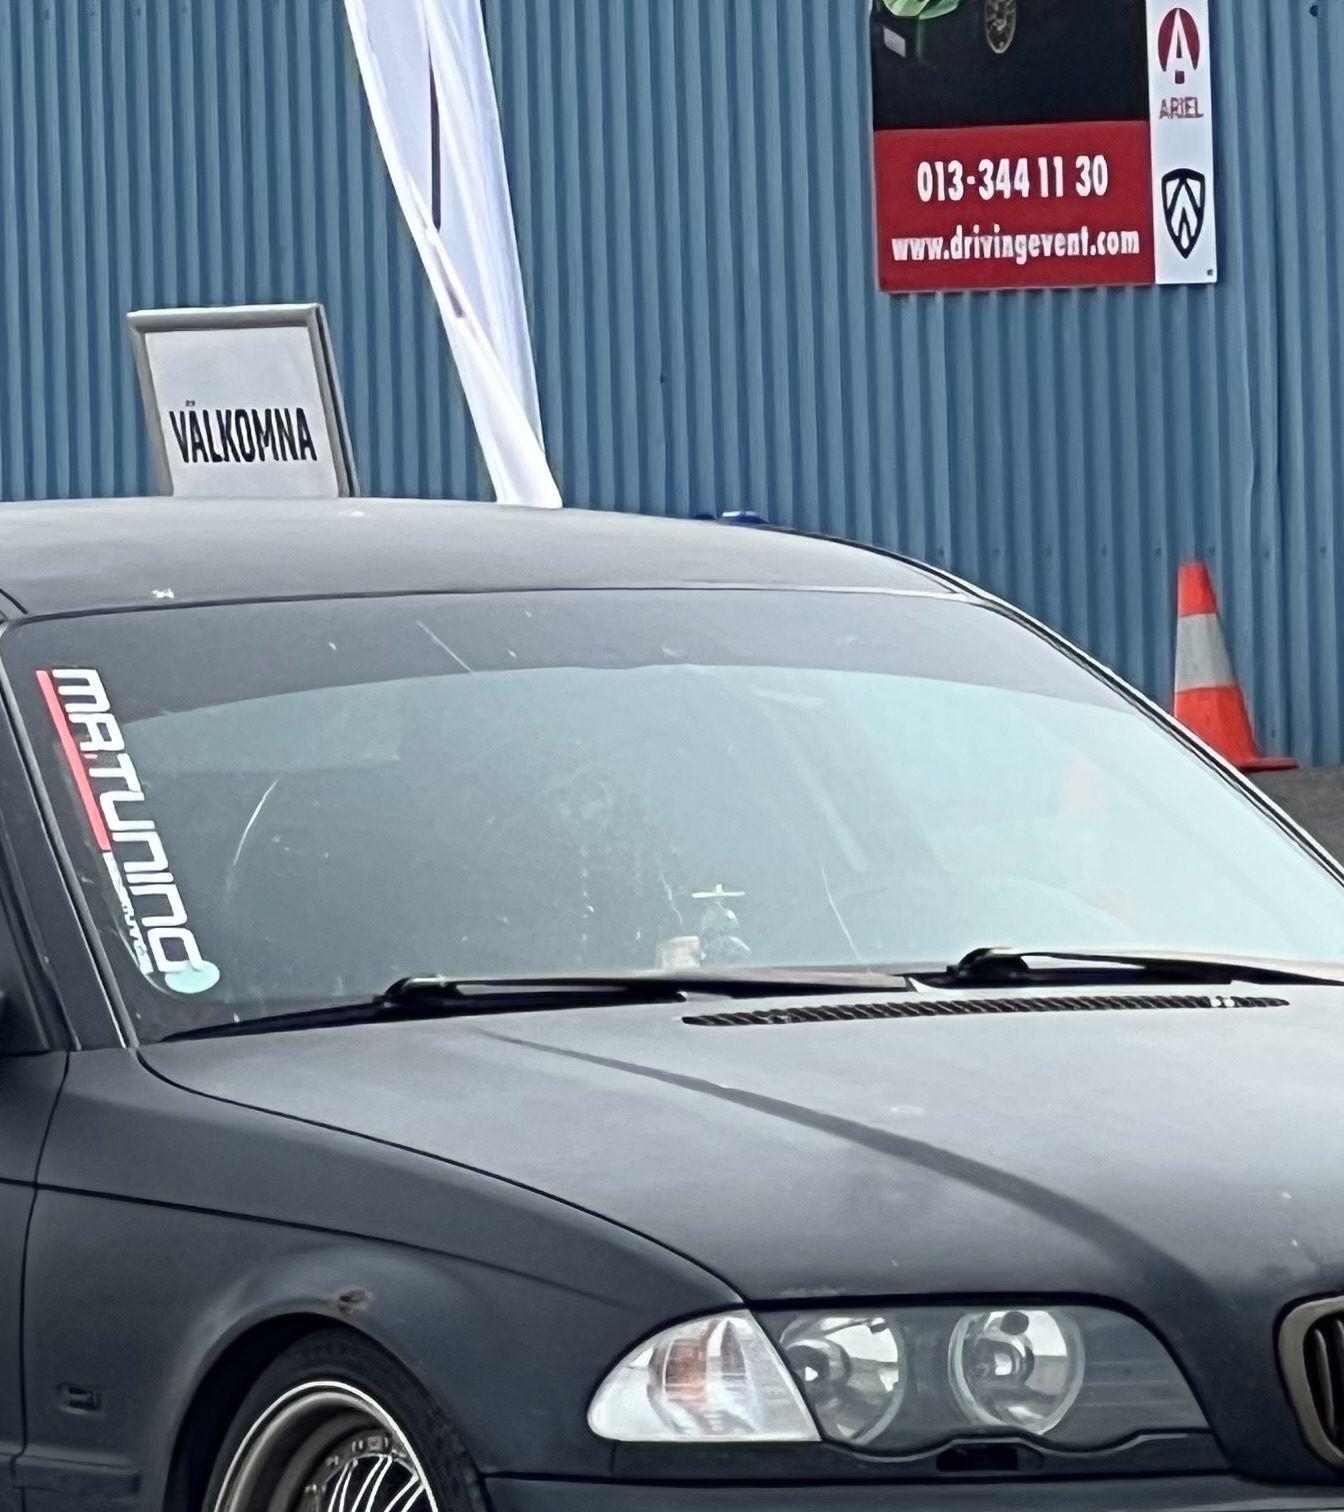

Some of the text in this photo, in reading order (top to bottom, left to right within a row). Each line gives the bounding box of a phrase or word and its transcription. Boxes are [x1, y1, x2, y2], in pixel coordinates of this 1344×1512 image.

[1159, 97, 1204, 119] ARIEL
[917, 155, 1109, 201] 013-344 11 30
[891, 224, 1140, 265] www.drivingevent.com
[169, 400, 318, 463] VÄLKOMNA
